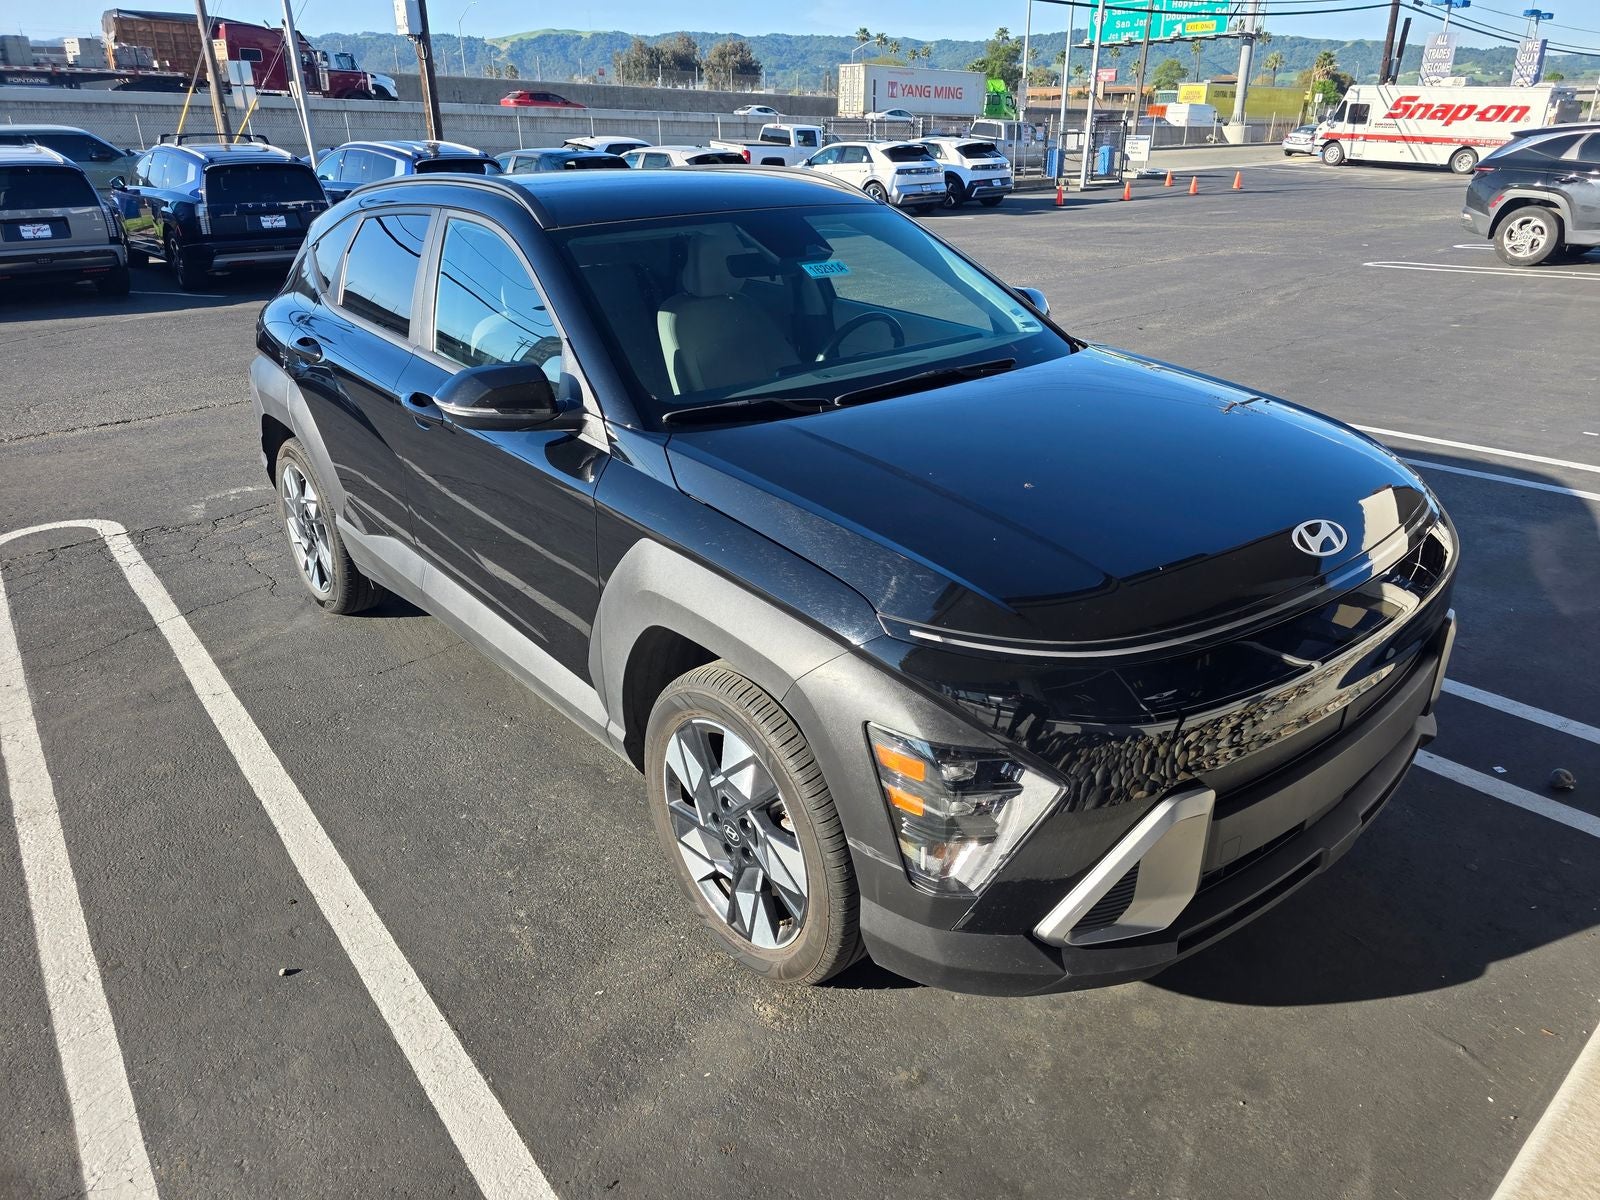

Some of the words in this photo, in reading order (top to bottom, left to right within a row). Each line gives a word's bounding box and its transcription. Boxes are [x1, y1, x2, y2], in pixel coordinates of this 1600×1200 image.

[1115, 20, 1131, 29] San
[1186, 23, 1200, 31] EXIT
[1200, 21, 1215, 29] ONLY
[1435, 35, 1448, 46] ALL
[1525, 41, 1540, 52] WE
[1427, 48, 1451, 60] TRADES
[1520, 52, 1540, 64] BUY
[1422, 62, 1451, 74] WELCOME
[1515, 64, 1539, 75] CARS
[900, 84, 931, 98] YANG
[934, 85, 963, 100] MING
[1382, 95, 1531, 127] Snap-on
